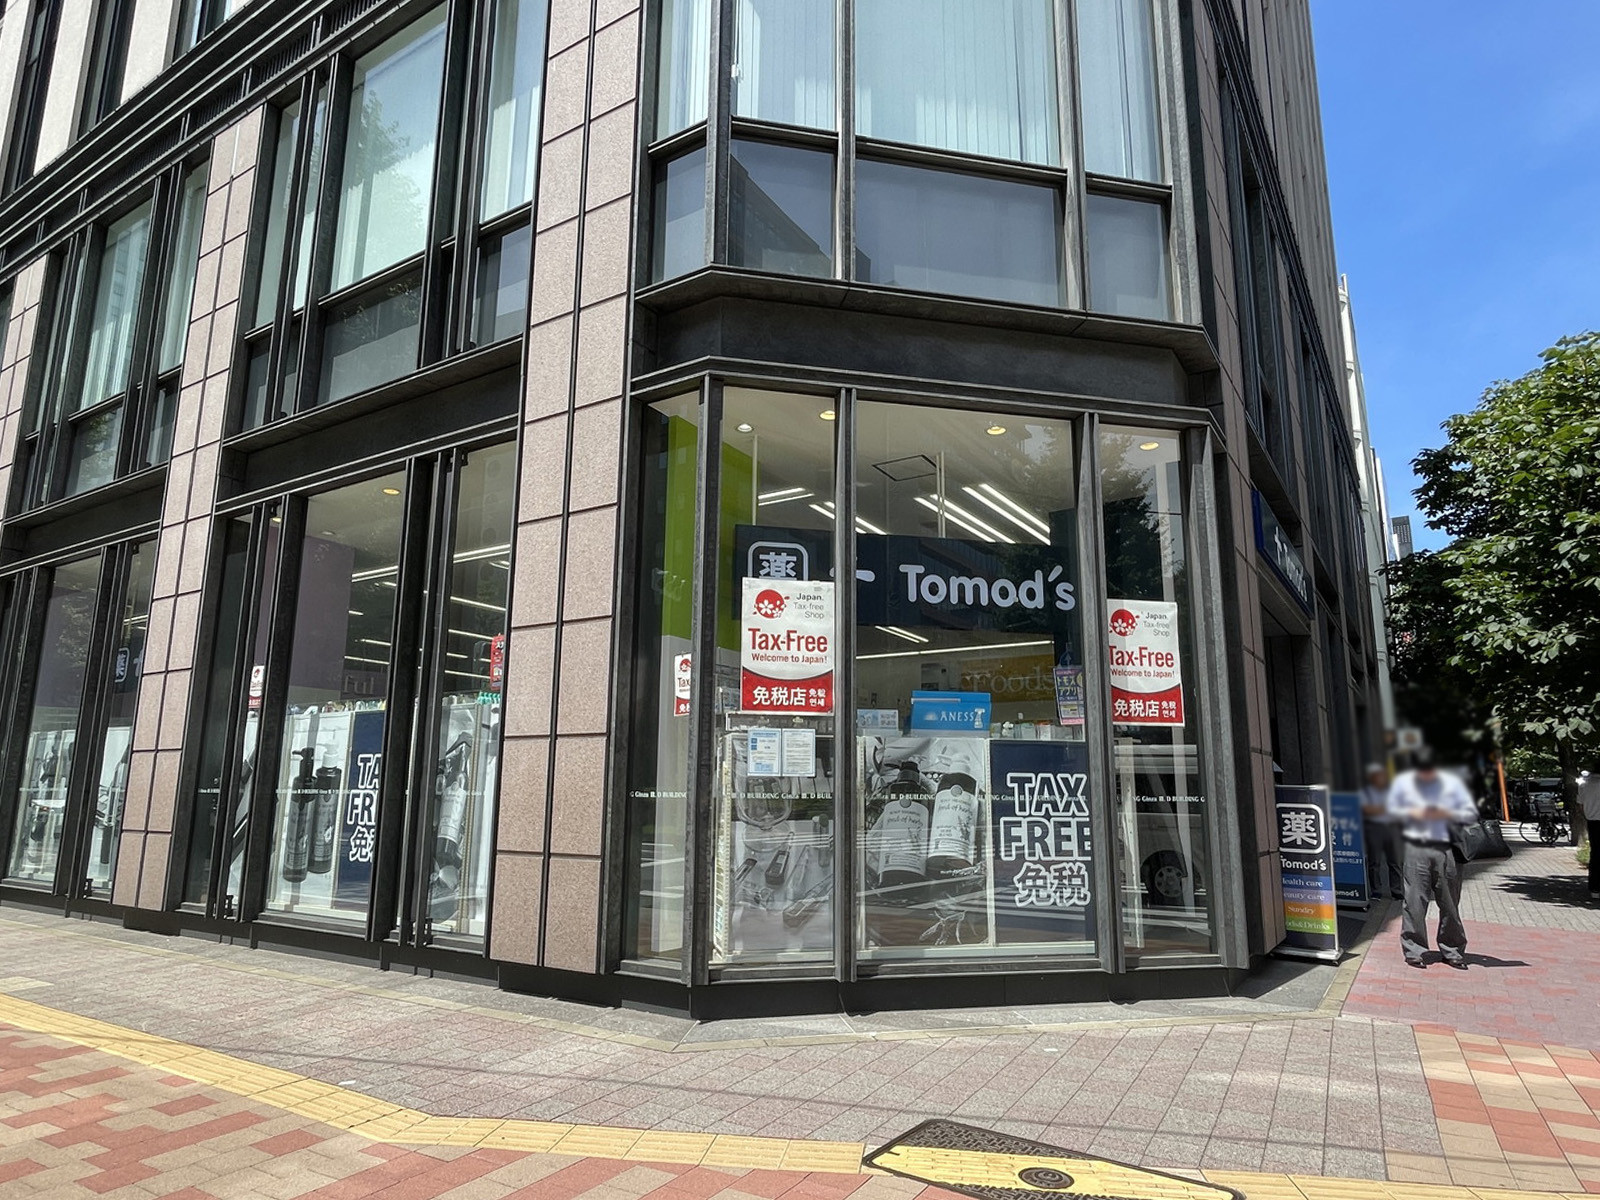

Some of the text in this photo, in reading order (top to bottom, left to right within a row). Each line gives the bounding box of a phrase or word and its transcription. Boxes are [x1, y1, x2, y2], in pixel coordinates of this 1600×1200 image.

[899, 564, 1076, 611] Tomod's
[804, 611, 824, 620] Shop
[748, 627, 828, 653] Tax-Free
[1153, 629, 1170, 638] Shop
[752, 653, 828, 665] Welcome to Japan!
[1109, 645, 1174, 668] Tax-Free
[1111, 668, 1142, 677] Welcome
[1153, 671, 1174, 679] Japan!
[752, 686, 806, 706] 免税店
[1114, 698, 1159, 717] 免税店
[357, 754, 382, 789] TA
[1006, 772, 1089, 816] TAX
[347, 790, 378, 825] FR
[1282, 811, 1318, 845] 薬
[1000, 817, 1091, 861] FREE
[1280, 858, 1327, 871] Tomod's
[1013, 862, 1091, 907] 免税
[1335, 889, 1360, 898] omod's
[1283, 892, 1305, 900] eauty
